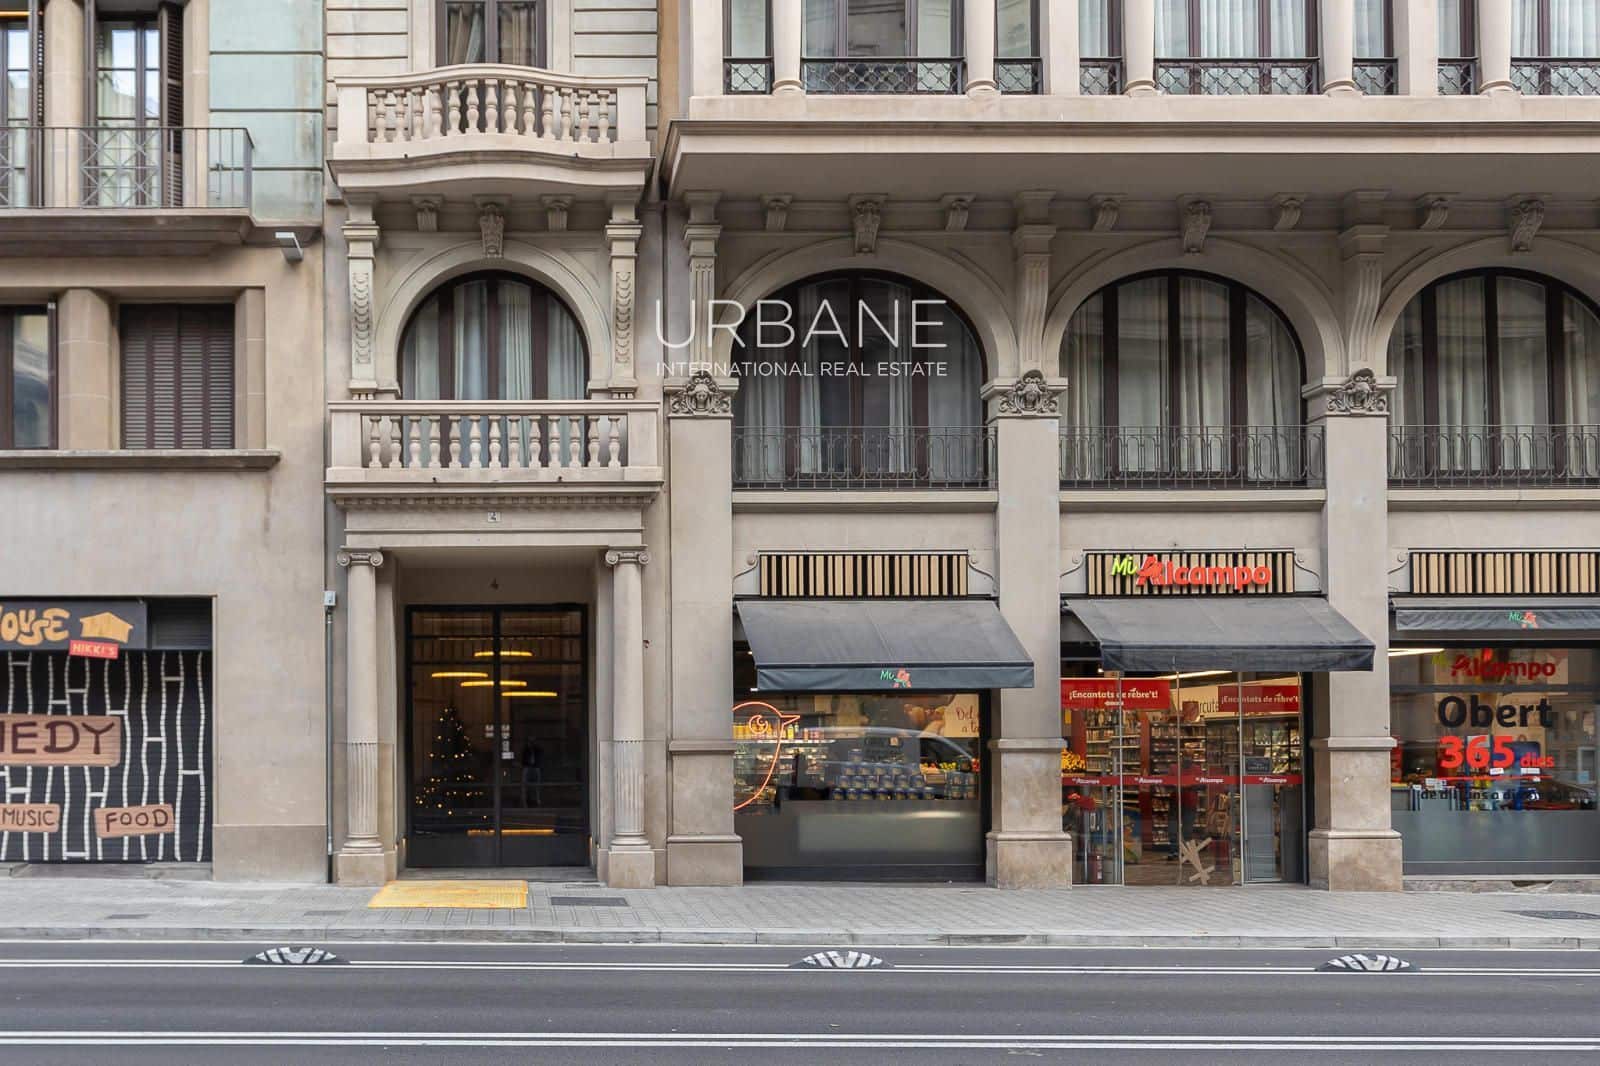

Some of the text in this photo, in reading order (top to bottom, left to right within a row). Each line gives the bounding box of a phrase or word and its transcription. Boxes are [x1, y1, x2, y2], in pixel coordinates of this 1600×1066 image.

[1111, 554, 1273, 591] Mi Alcampo
[0, 604, 70, 646] OUSE
[1451, 654, 1557, 681] Alcampo
[1438, 694, 1553, 729] Obert
[1439, 735, 1555, 769] 365 dies
[2, 808, 55, 827] MUSIC
[106, 808, 169, 833] FOOD
